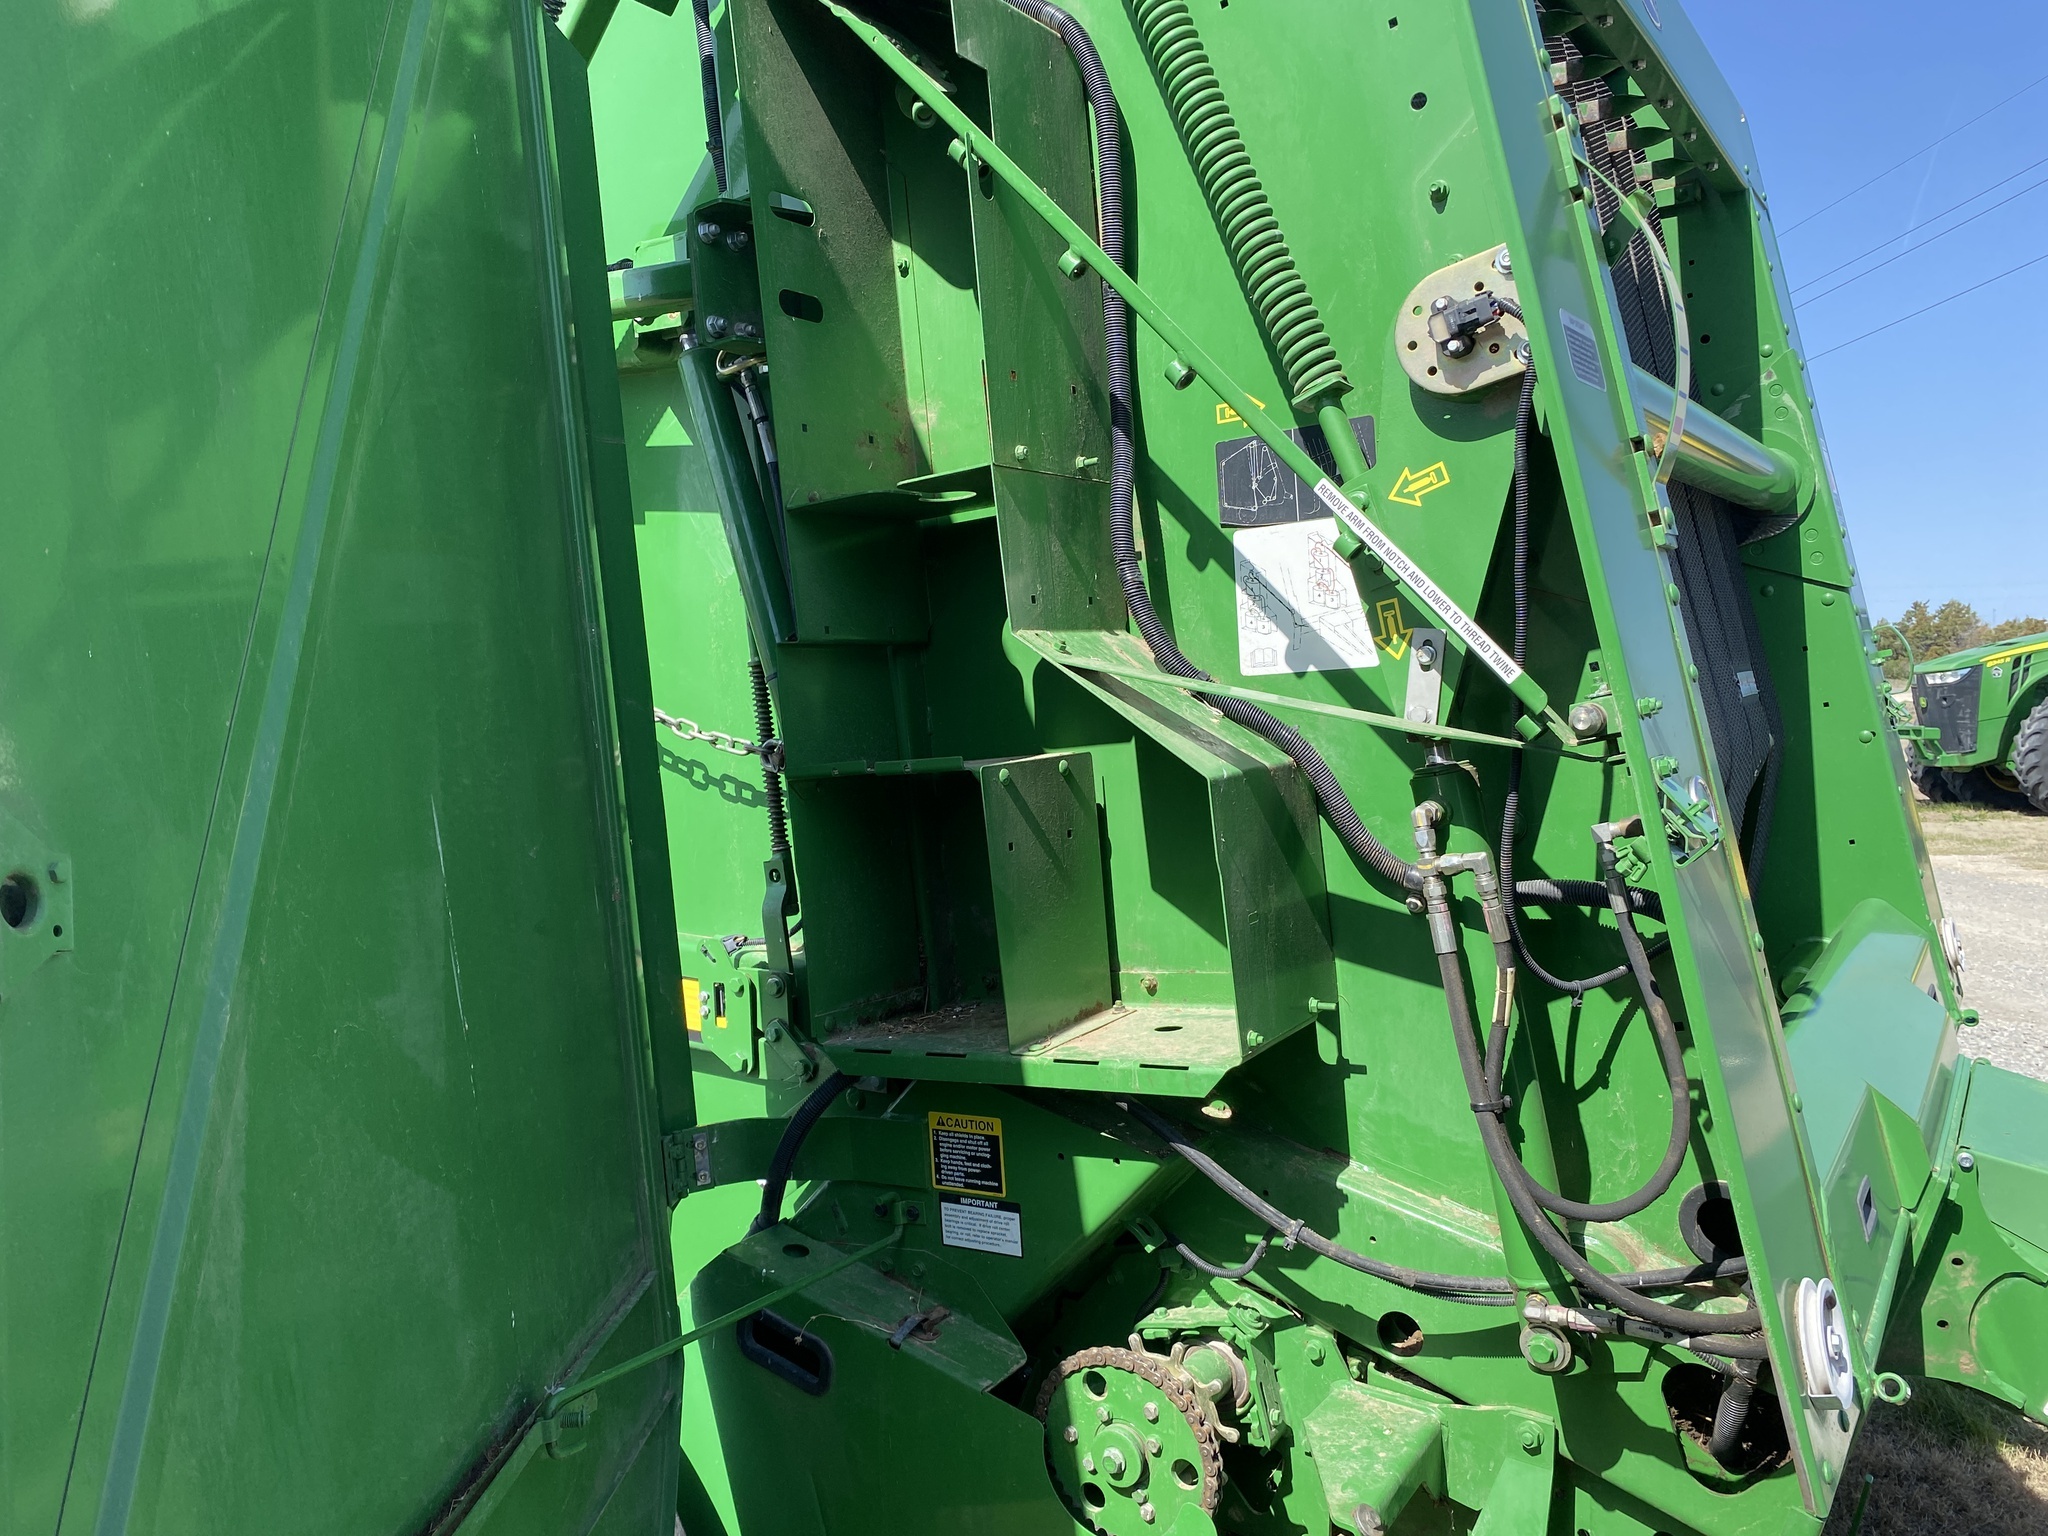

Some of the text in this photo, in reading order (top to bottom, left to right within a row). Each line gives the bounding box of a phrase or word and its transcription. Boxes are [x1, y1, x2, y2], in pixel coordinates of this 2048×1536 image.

[1317, 485, 1515, 679] REMOVE ARM FROM NOTCH AND LOWER TO THREAD TWINE
[946, 1118, 994, 1131] CAUTION
[960, 1197, 998, 1208] IMPORTANT
